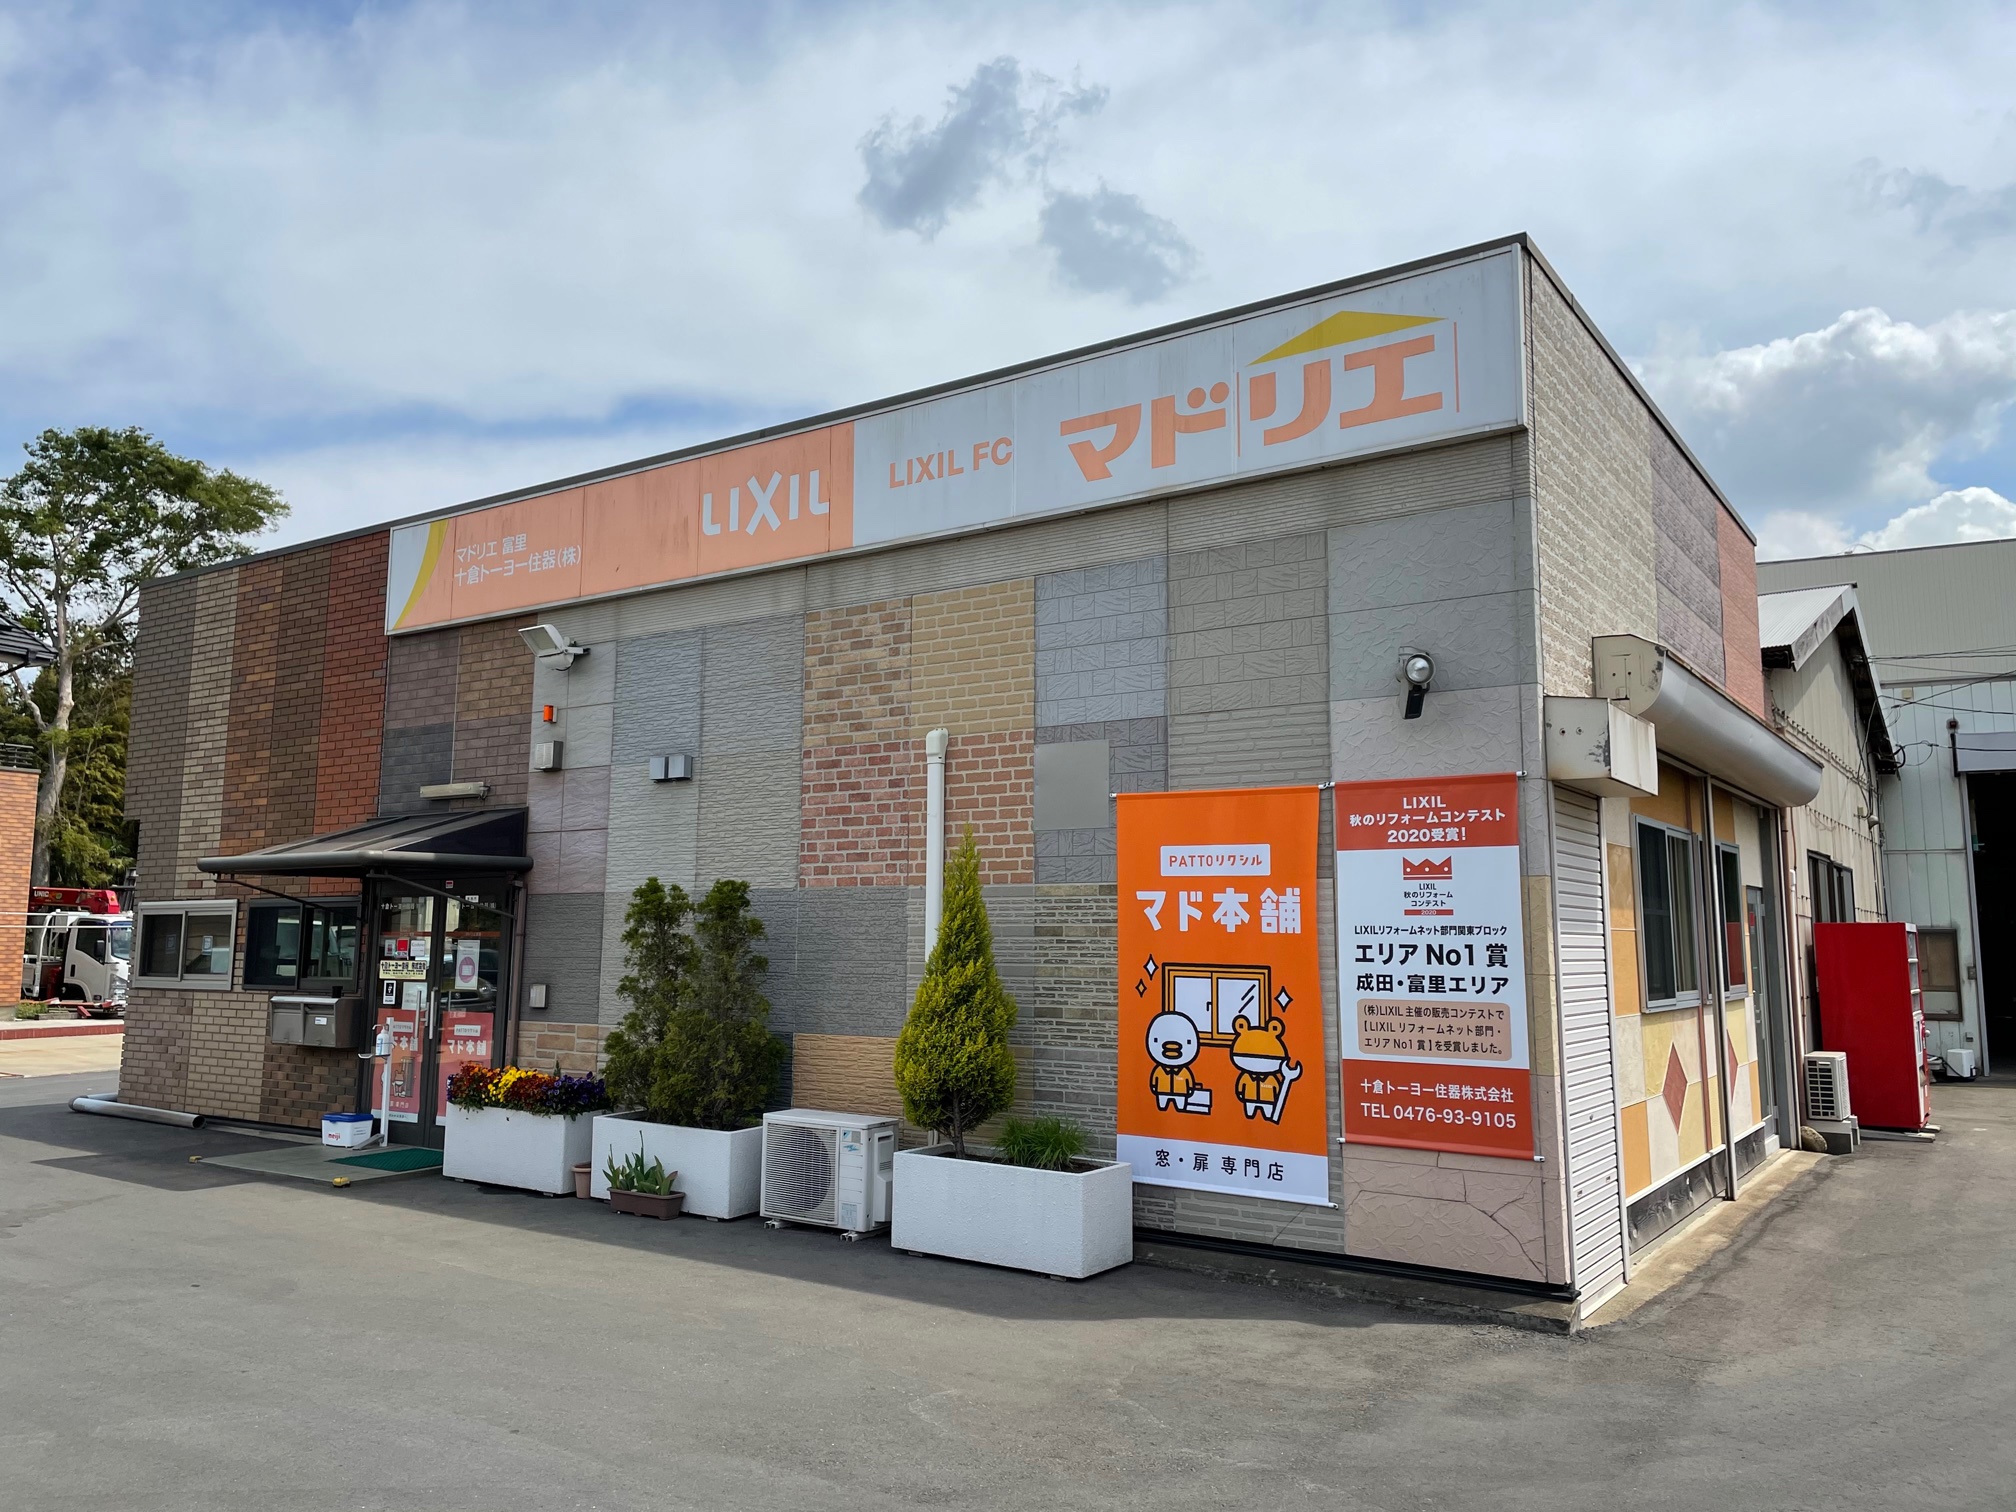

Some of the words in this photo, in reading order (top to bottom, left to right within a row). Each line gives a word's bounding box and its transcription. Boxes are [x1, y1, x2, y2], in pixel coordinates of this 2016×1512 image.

[1060, 334, 1443, 482] マドリエ
[889, 450, 964, 489] LIXIL
[973, 437, 1013, 471] FC
[702, 470, 830, 536] LIXIL
[456, 541, 497, 563] マドリエ
[502, 533, 527, 555] 富里
[454, 545, 581, 587] 十倉トーヨー住器(株)
[1403, 796, 1446, 809] LIXIL
[1350, 808, 1506, 827] 秋のリフォームコンテスト
[1387, 827, 1466, 843] 2020受賞!
[1169, 854, 1263, 867] PATTOリクシル
[34, 890, 50, 898] UNIC
[1404, 891, 1453, 899] 秋のリフォーム
[1419, 883, 1437, 891] LIXIL
[1136, 887, 1301, 934] マド本舗
[1354, 925, 1507, 936] LIXILリフォームネット部門関東ブロック
[1355, 943, 1419, 966] エリア
[1426, 943, 1475, 966] No1
[1486, 943, 1509, 968] 賞
[1356, 973, 1509, 995] 成田・富里エリア
[1363, 1004, 1403, 1017] (株)LIXIL
[1405, 1006, 1504, 1020] 主催の販売コンテストで
[447, 1039, 487, 1056] マド本舗
[1365, 1038, 1390, 1048] エリア
[1393, 1039, 1413, 1050] No1
[1360, 1078, 1514, 1103] 十倉トーヨー住器株式会社
[1360, 1103, 1390, 1119] TEL
[1393, 1105, 1517, 1129] 0476-93-9105
[1155, 1149, 1209, 1172] 窓・扉
[1221, 1156, 1284, 1181] 専門店
